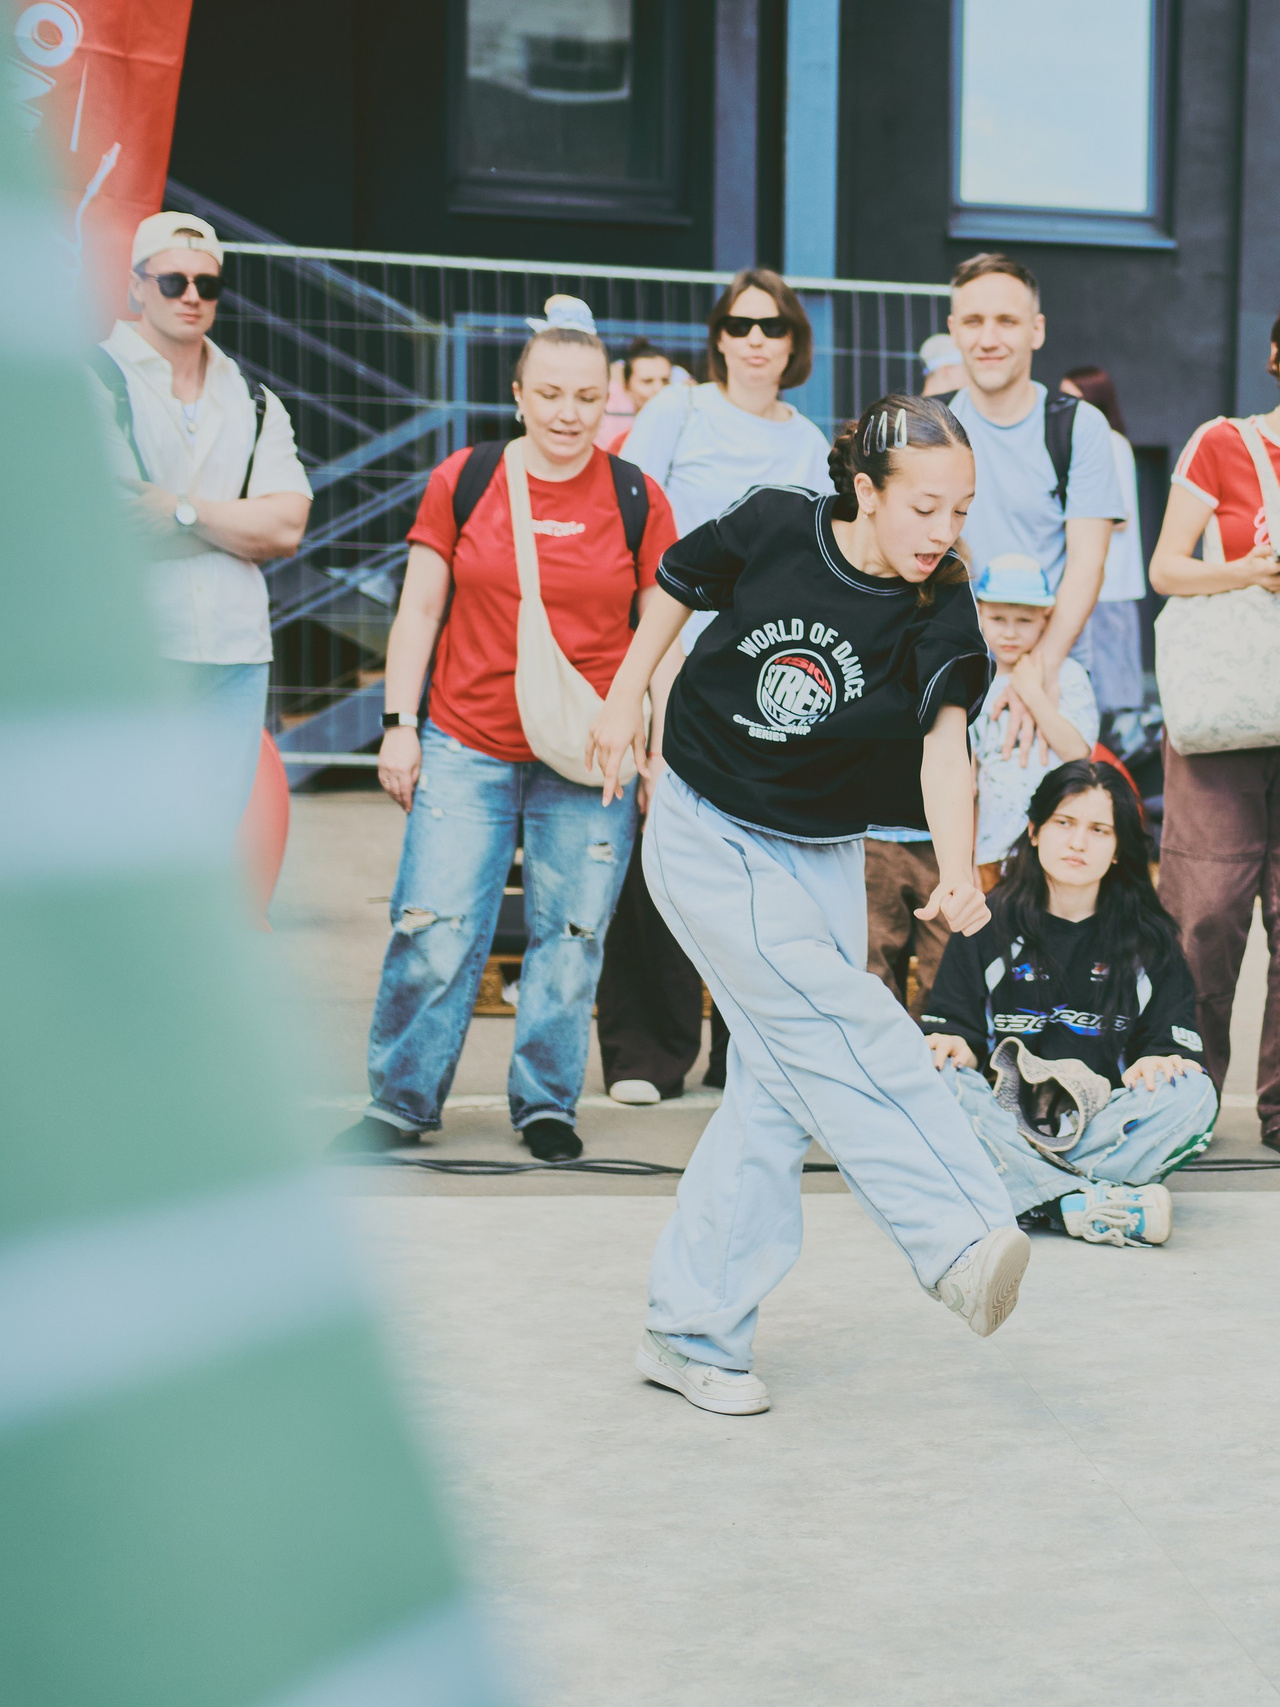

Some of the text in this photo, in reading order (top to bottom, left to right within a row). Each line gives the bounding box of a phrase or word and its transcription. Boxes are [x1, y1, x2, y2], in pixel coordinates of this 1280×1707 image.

[737, 618, 865, 702] WORLD OF DANCE
[774, 656, 832, 696] VISION
[748, 726, 787, 742] SERIES
